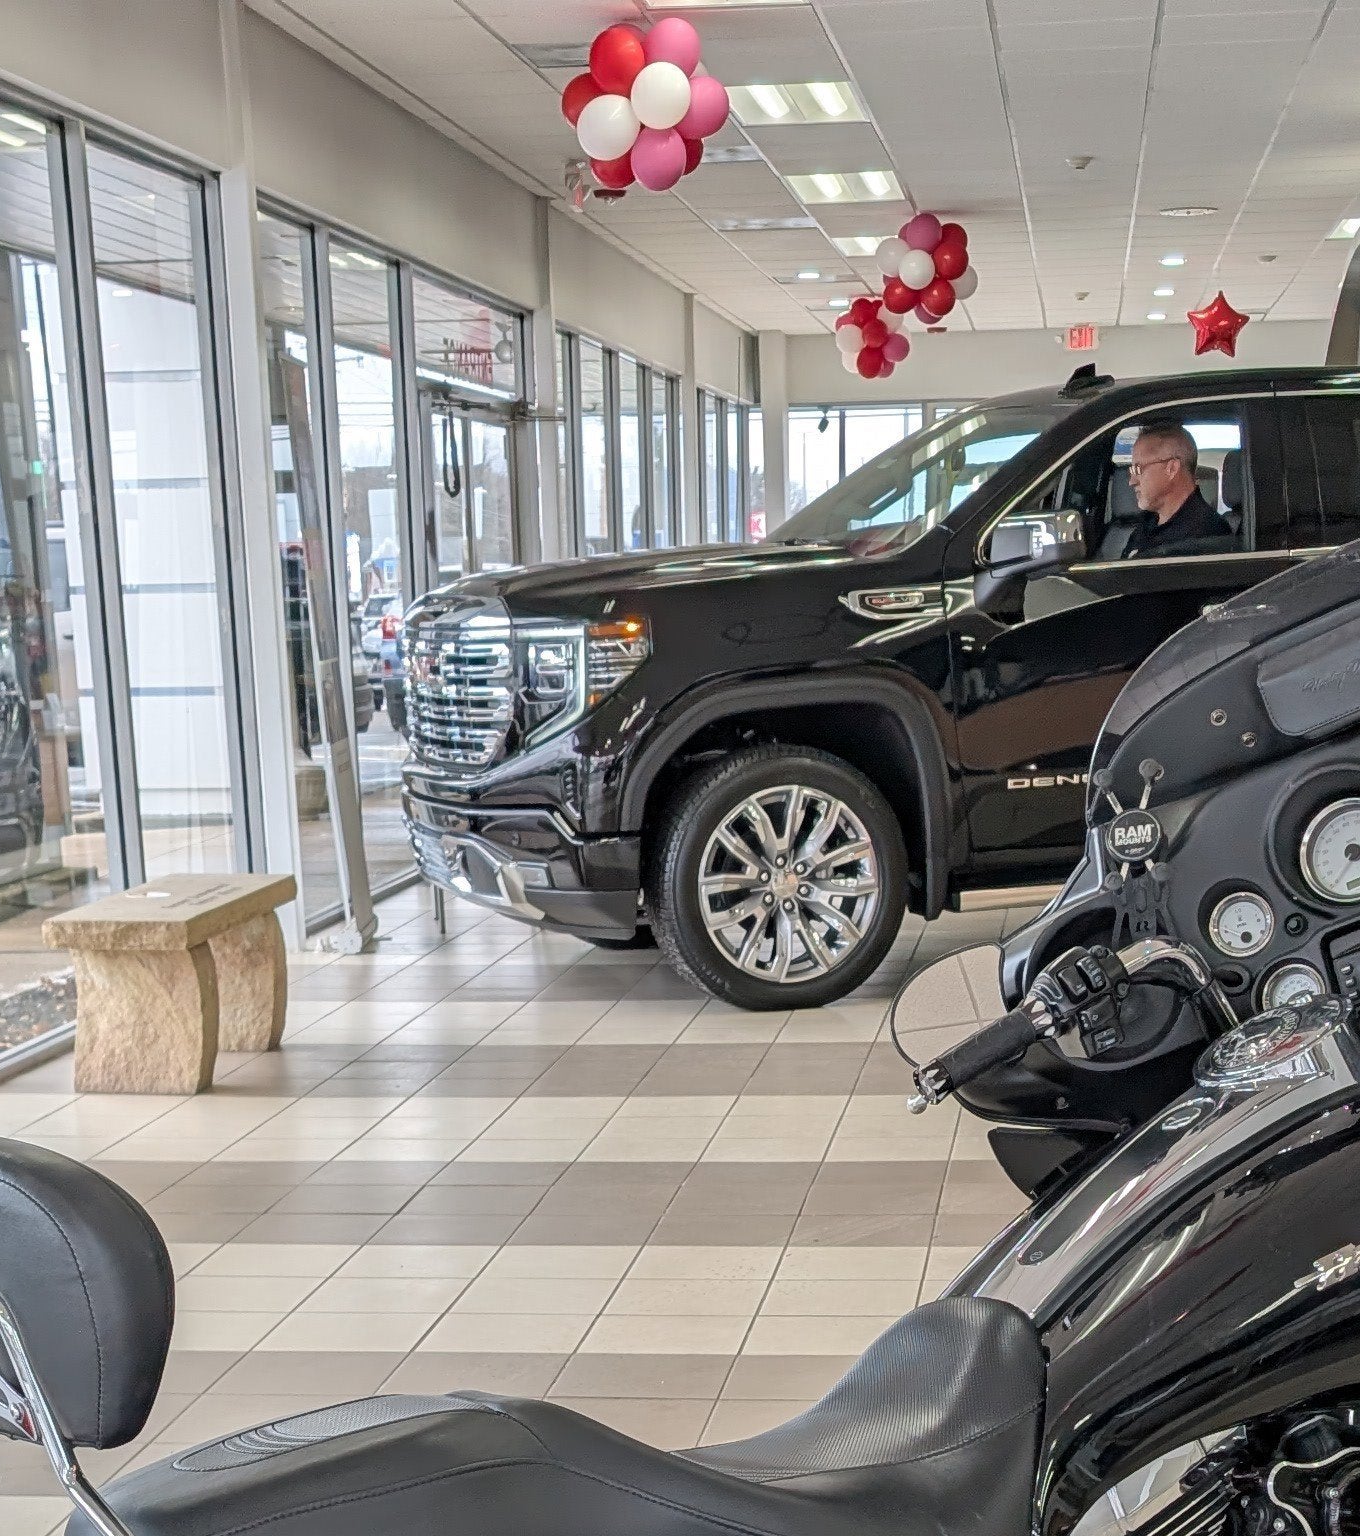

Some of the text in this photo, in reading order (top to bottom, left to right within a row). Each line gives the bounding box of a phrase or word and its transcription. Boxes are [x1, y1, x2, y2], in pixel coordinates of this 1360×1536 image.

[1069, 327, 1094, 348] EXIT
[1007, 774, 1089, 790] DEN
[1114, 823, 1152, 841] RAM
